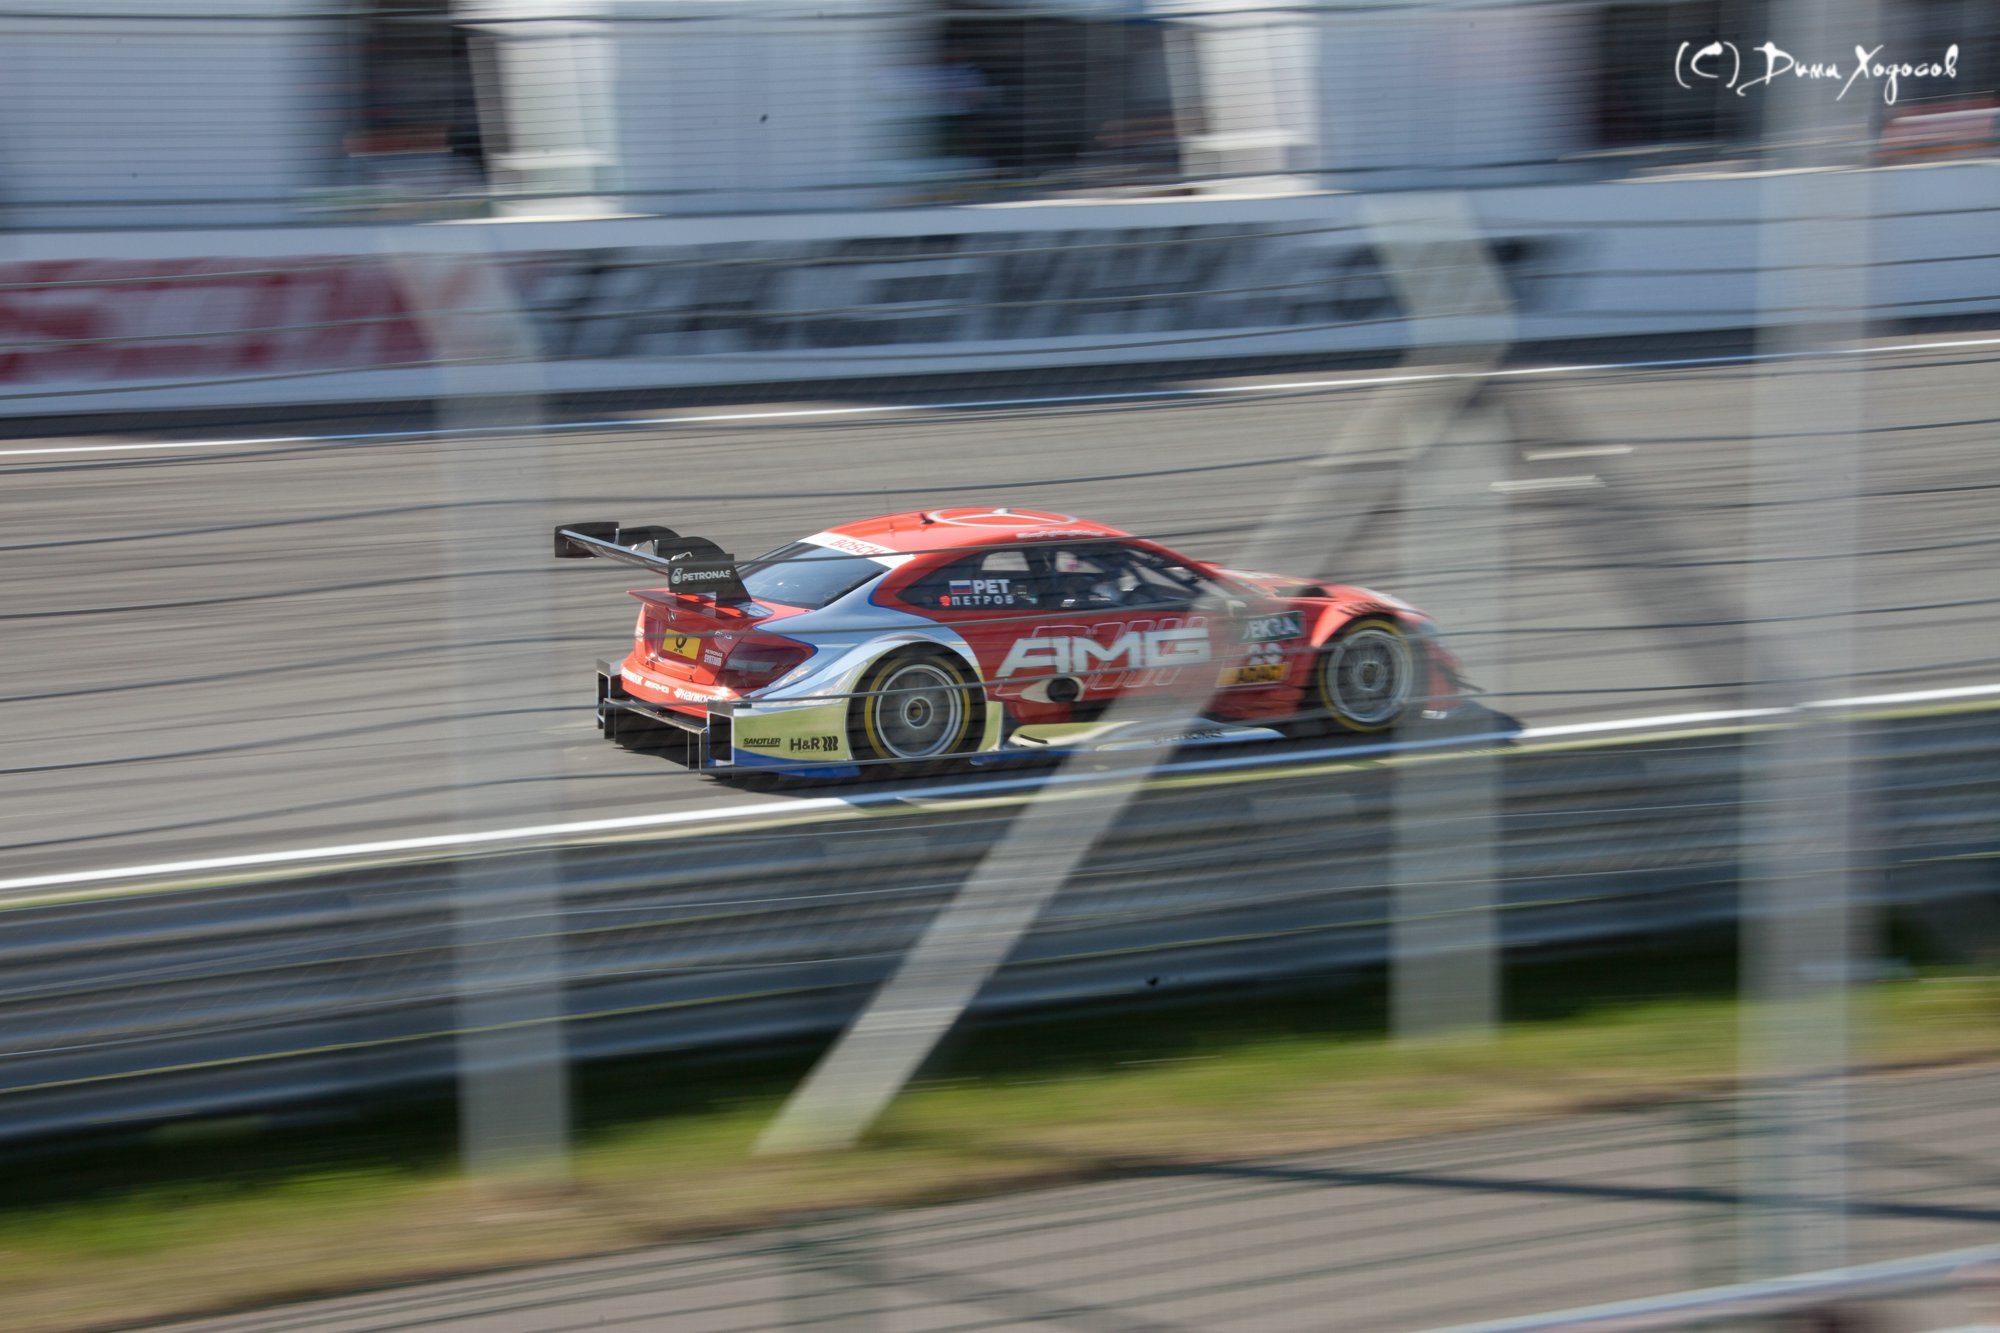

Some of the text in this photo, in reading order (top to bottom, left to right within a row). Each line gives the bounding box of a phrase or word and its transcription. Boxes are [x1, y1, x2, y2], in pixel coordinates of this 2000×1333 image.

[682, 569, 731, 582] PETRONAS
[951, 595, 1015, 605] ПЕТРОВ
[995, 627, 1211, 677] AMG
[743, 737, 781, 745] SANDTLER
[790, 737, 820, 751] H&R
